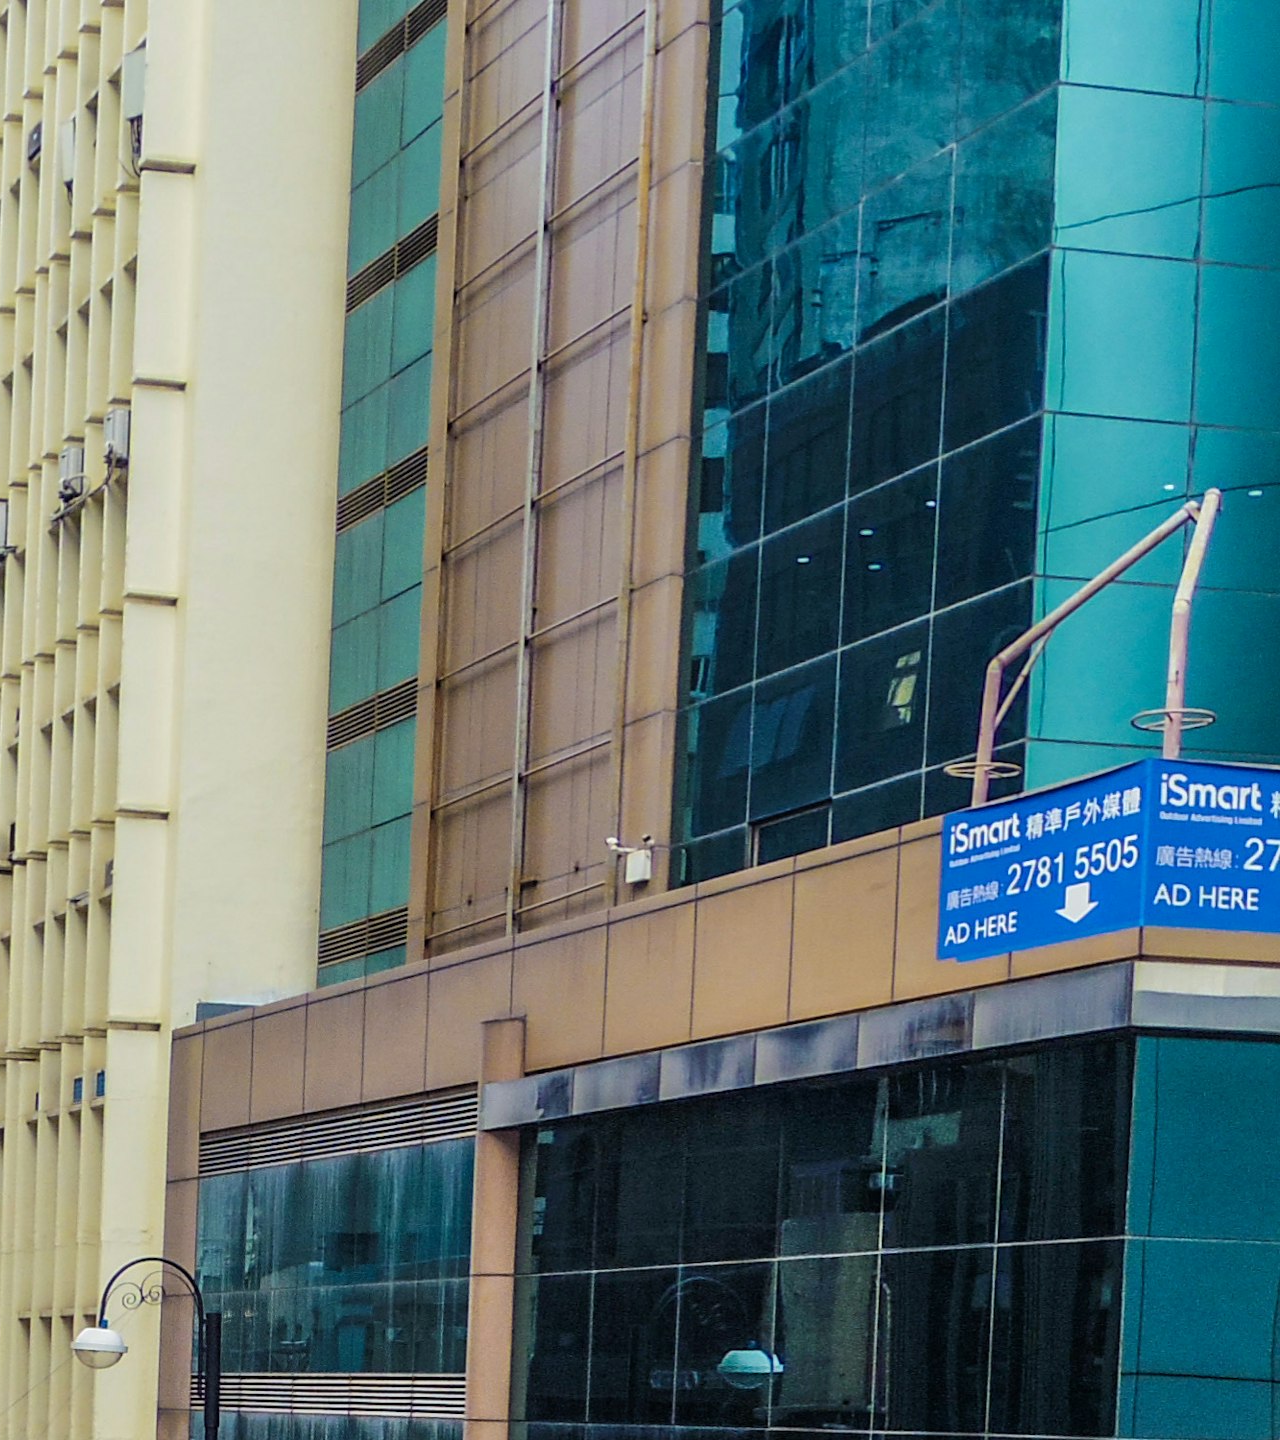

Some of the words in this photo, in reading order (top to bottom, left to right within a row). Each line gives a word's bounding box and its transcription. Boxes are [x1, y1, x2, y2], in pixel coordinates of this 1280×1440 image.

[1160, 773, 1263, 812] iSmart
[950, 812, 1021, 855] iSmart
[1025, 786, 1141, 841] 精準戶外媒體
[1006, 851, 1064, 896] 2781
[1074, 834, 1139, 880] 5505
[1154, 883, 1190, 908] AD
[1199, 886, 1260, 911] HERE
[944, 922, 970, 948] AD
[974, 911, 1018, 941] HERE
